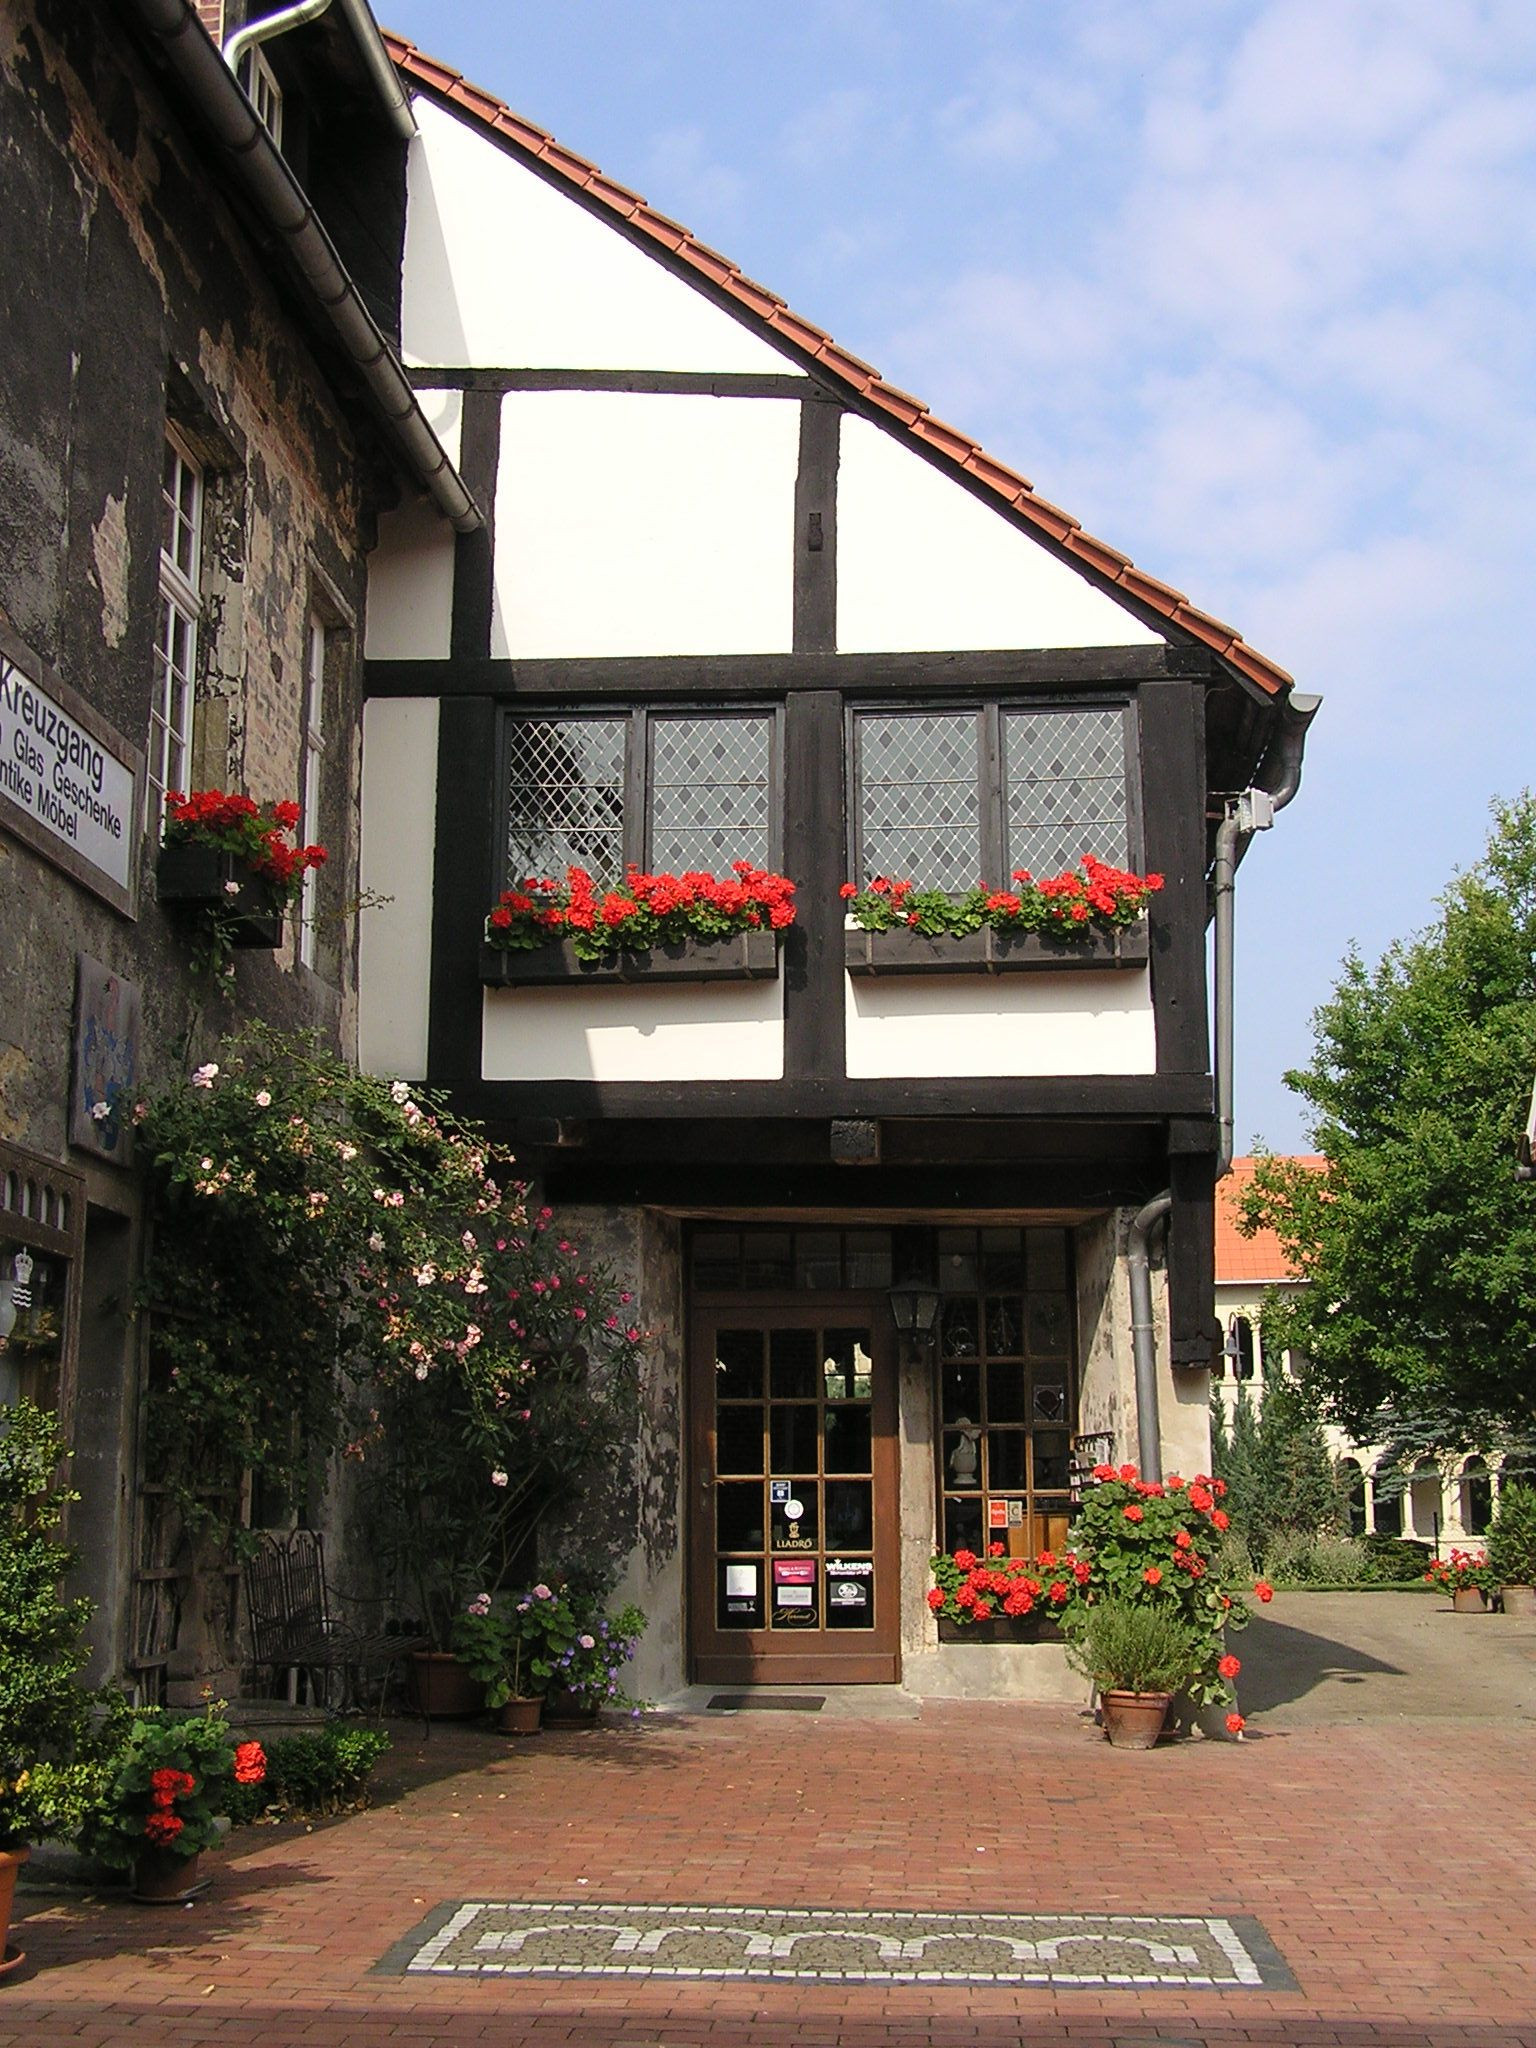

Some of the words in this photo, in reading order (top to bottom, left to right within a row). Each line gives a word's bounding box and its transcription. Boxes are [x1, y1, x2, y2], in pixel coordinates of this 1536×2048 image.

[0, 657, 104, 793] Kreuzgang
[0, 759, 32, 804] ntike
[38, 783, 77, 840] Möbel
[14, 728, 44, 777] Glas
[53, 761, 121, 839] Geschenke
